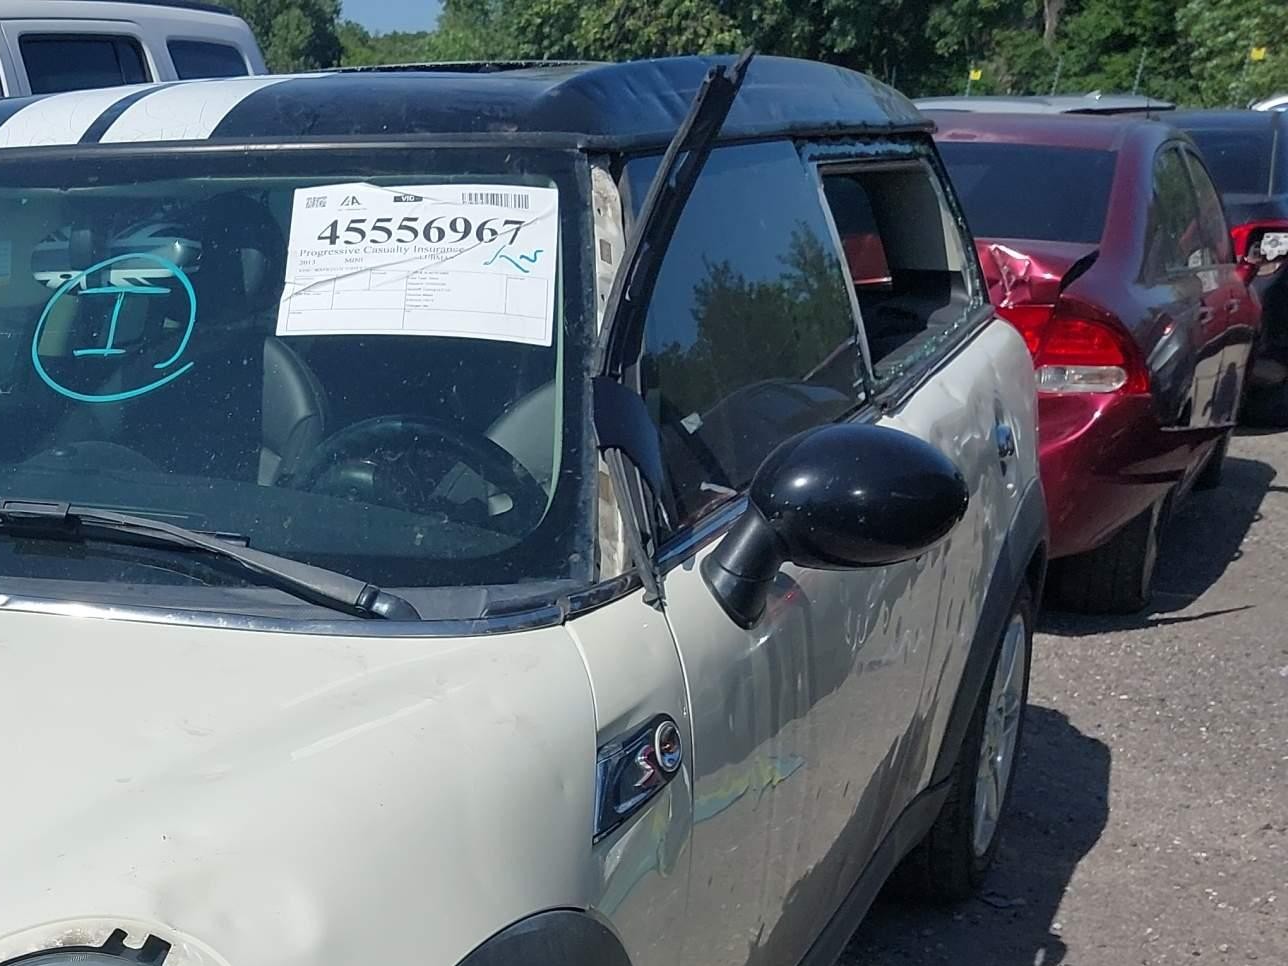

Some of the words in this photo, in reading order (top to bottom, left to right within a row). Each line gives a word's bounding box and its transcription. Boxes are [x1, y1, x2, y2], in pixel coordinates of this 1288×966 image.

[317, 216, 526, 246] 45556967
[300, 246, 361, 258] Progressive
[363, 244, 410, 256] Casualty
[413, 244, 465, 254] Insurance
